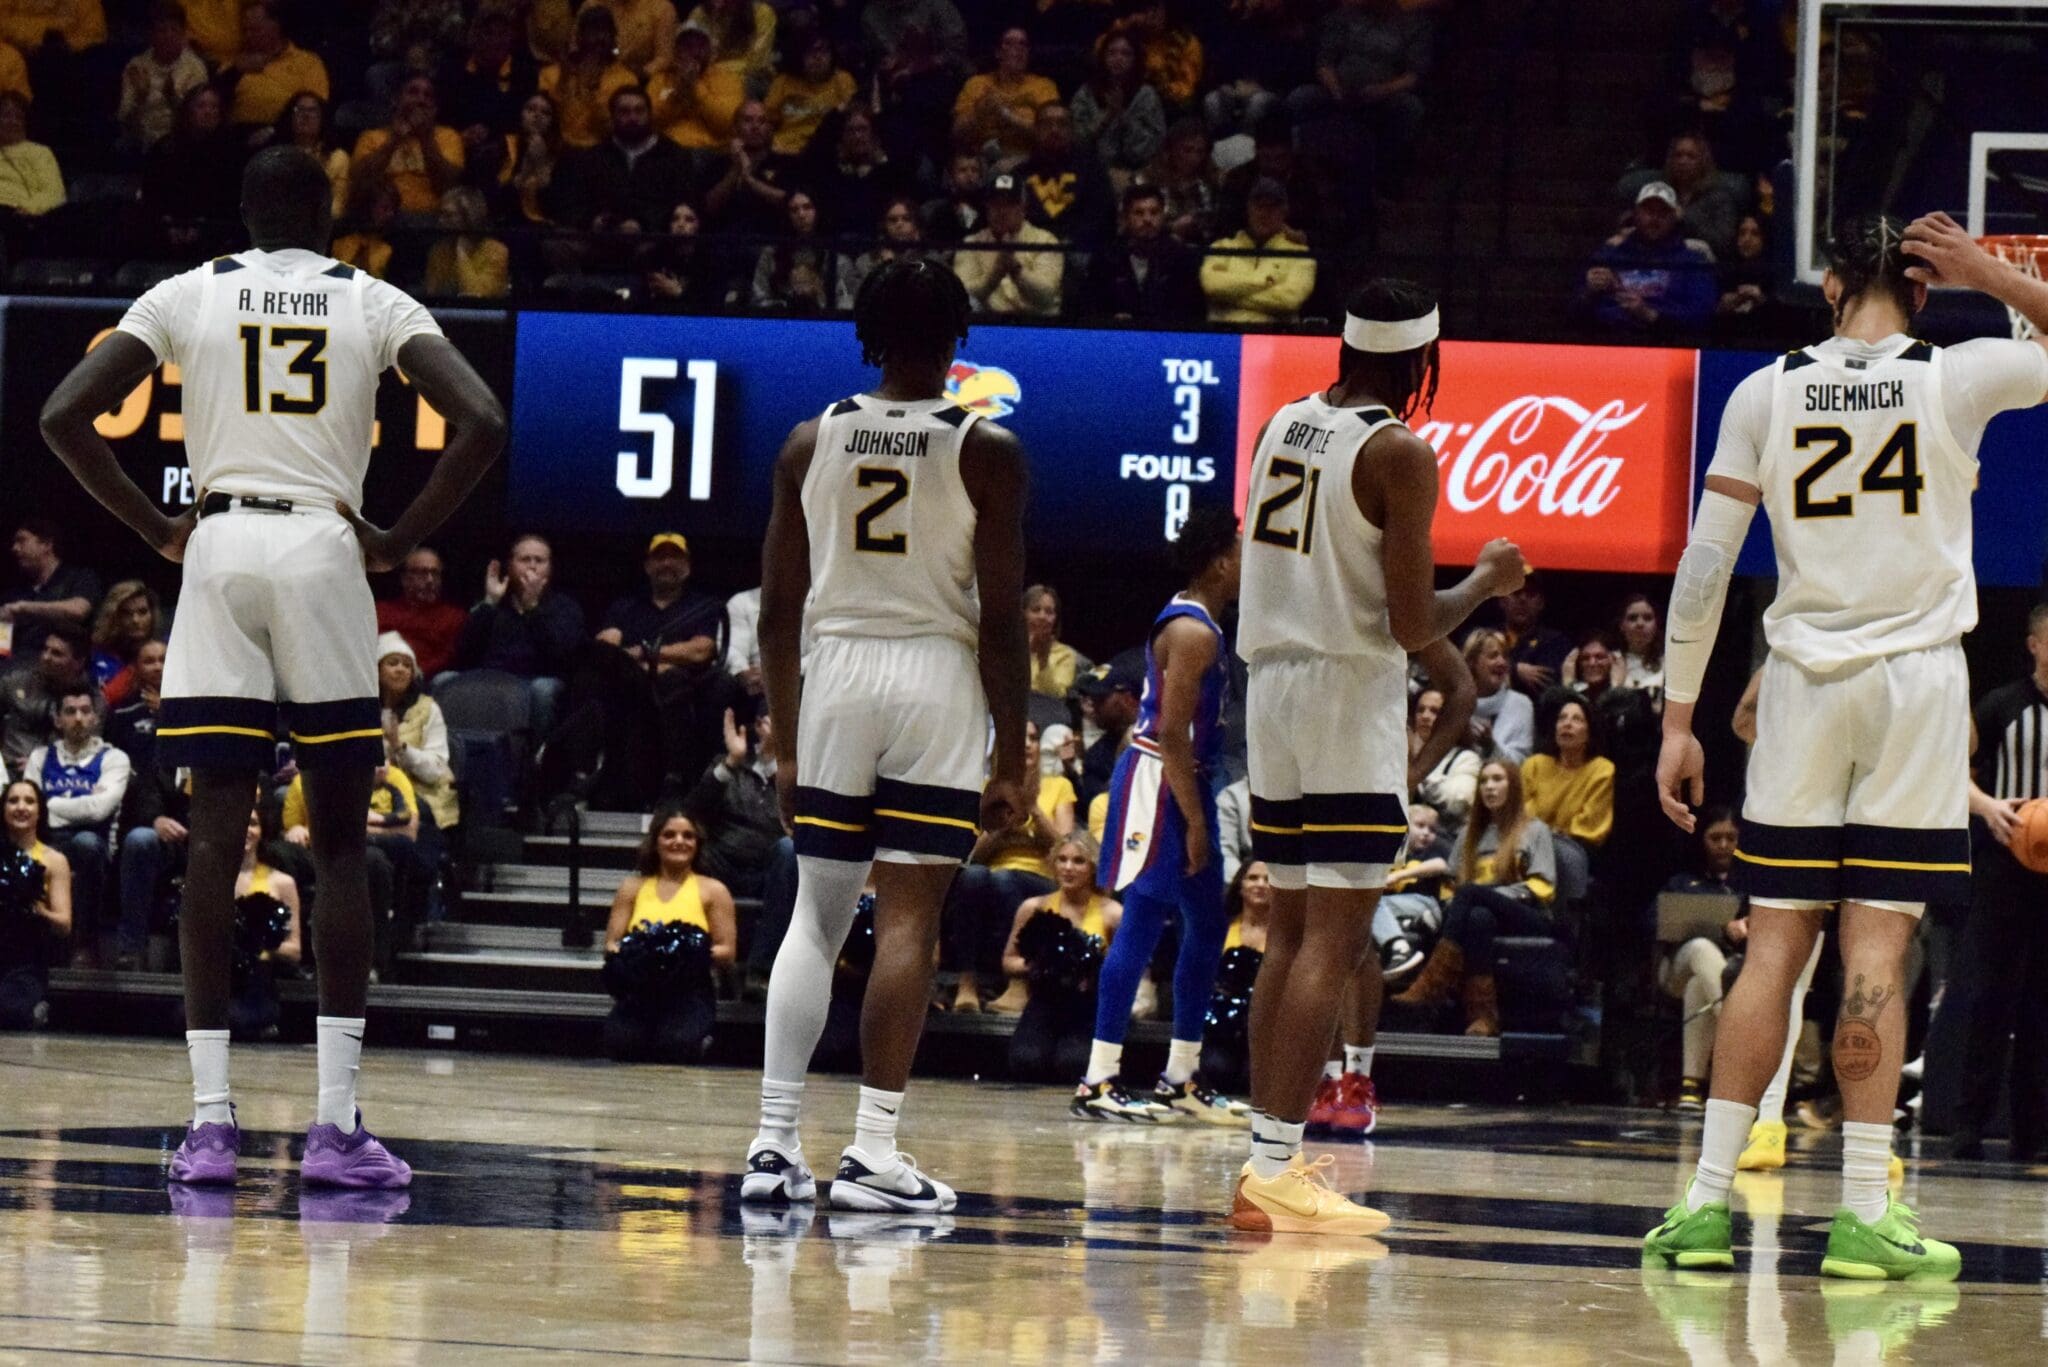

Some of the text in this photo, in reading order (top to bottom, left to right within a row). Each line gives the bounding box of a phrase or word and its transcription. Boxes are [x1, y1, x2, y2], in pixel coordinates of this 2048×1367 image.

[239, 288, 328, 316] A. REYAK
[239, 322, 329, 415] 13
[1162, 359, 1220, 384] TOL
[1173, 384, 1200, 444] 3
[1805, 379, 1904, 412] SUEMNICK
[616, 357, 717, 500] 51
[845, 429, 929, 457] JOHNSON
[163, 466, 193, 505] PE
[1120, 454, 1216, 482] FOULS
[1792, 419, 1926, 520] 24
[855, 466, 910, 554] 2
[1252, 455, 1321, 557] 21
